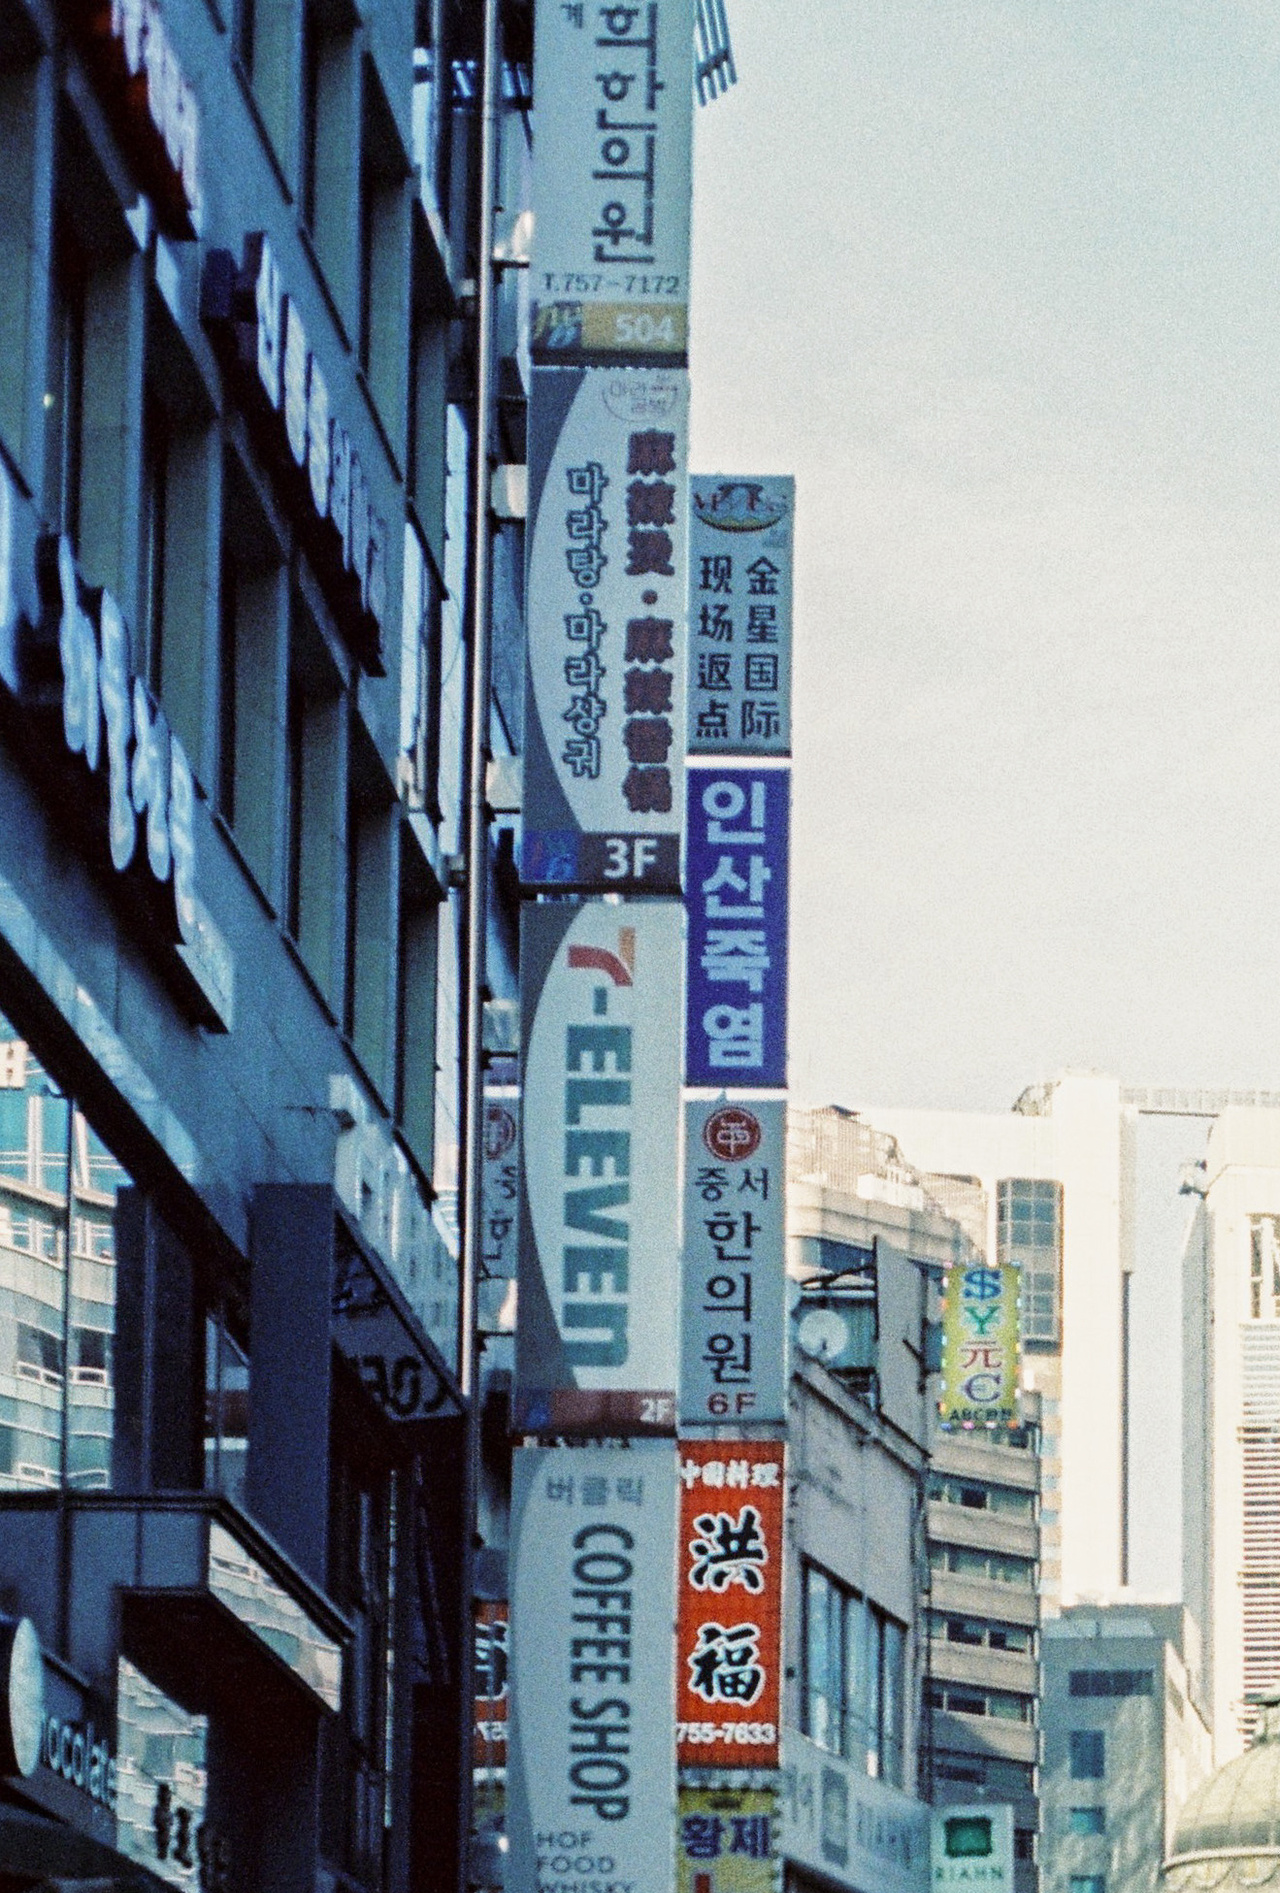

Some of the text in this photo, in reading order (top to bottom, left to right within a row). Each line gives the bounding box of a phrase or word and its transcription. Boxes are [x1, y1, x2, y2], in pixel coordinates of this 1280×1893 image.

[543, 272, 680, 294] T.757-7172
[614, 312, 676, 346] 504
[697, 555, 733, 739] 现场返点
[742, 555, 780, 739] 金星国际
[603, 838, 657, 880] 3F
[700, 780, 771, 1068] 인산죽염
[702, 1210, 762, 1385] 한의원
[708, 1392, 757, 1416] 6F
[688, 1506, 769, 1705] 洪福
[567, 1523, 637, 1823] COFFEE SHOP
[537, 1831, 591, 1849] HOF
[682, 1814, 769, 1860] 황제
[536, 1856, 614, 1873] FOOD
